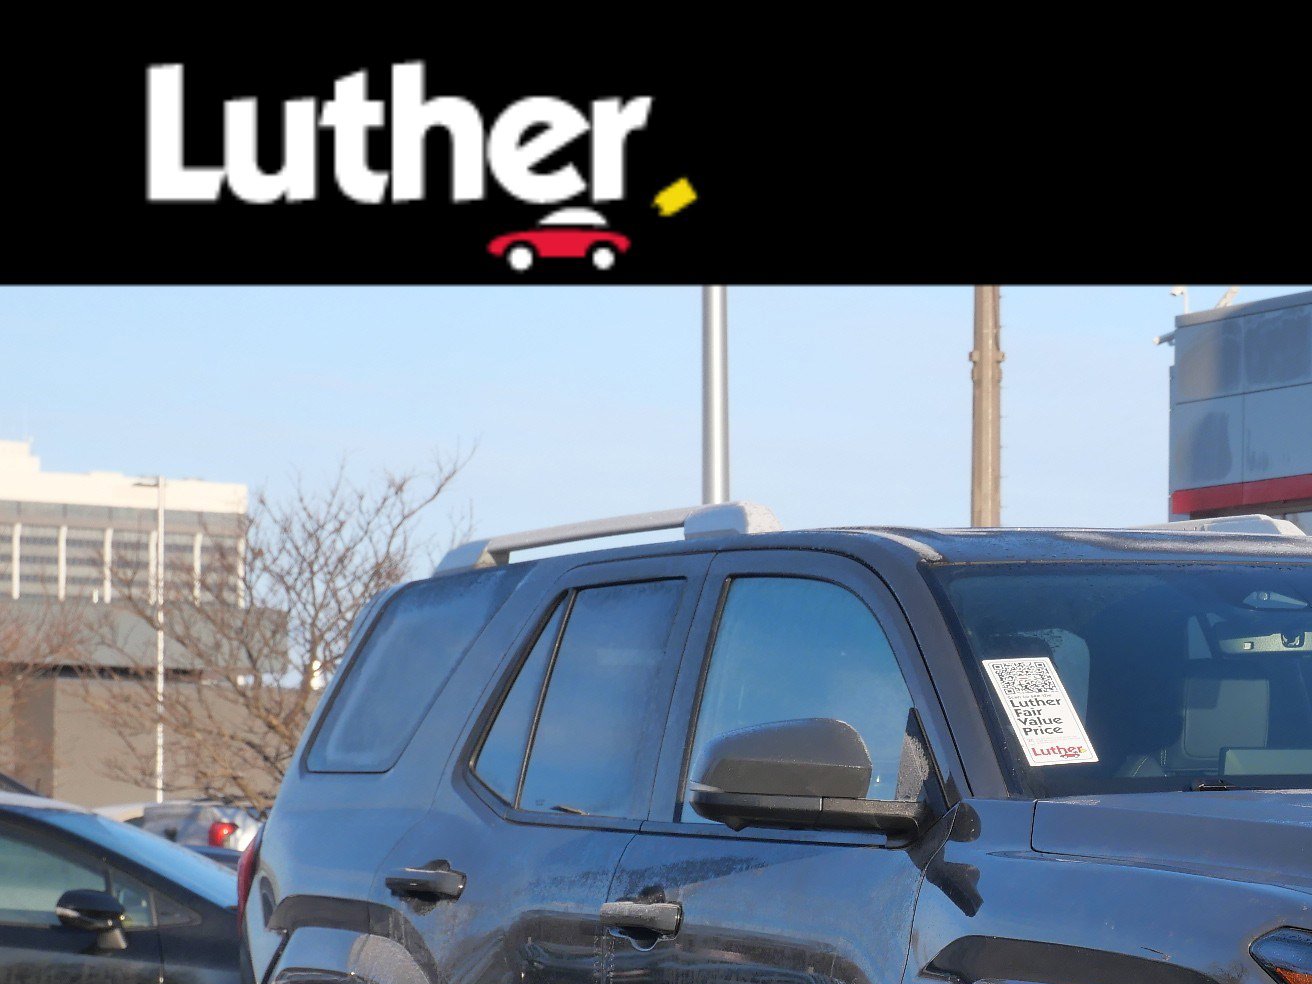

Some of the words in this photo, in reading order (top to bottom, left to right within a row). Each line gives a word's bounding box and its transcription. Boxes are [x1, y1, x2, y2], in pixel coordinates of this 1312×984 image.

[1010, 698, 1061, 708] Luther
[1014, 707, 1042, 718] Fair
[1017, 717, 1063, 727] Value
[1022, 726, 1063, 736] Price
[1031, 746, 1083, 756] Luther
